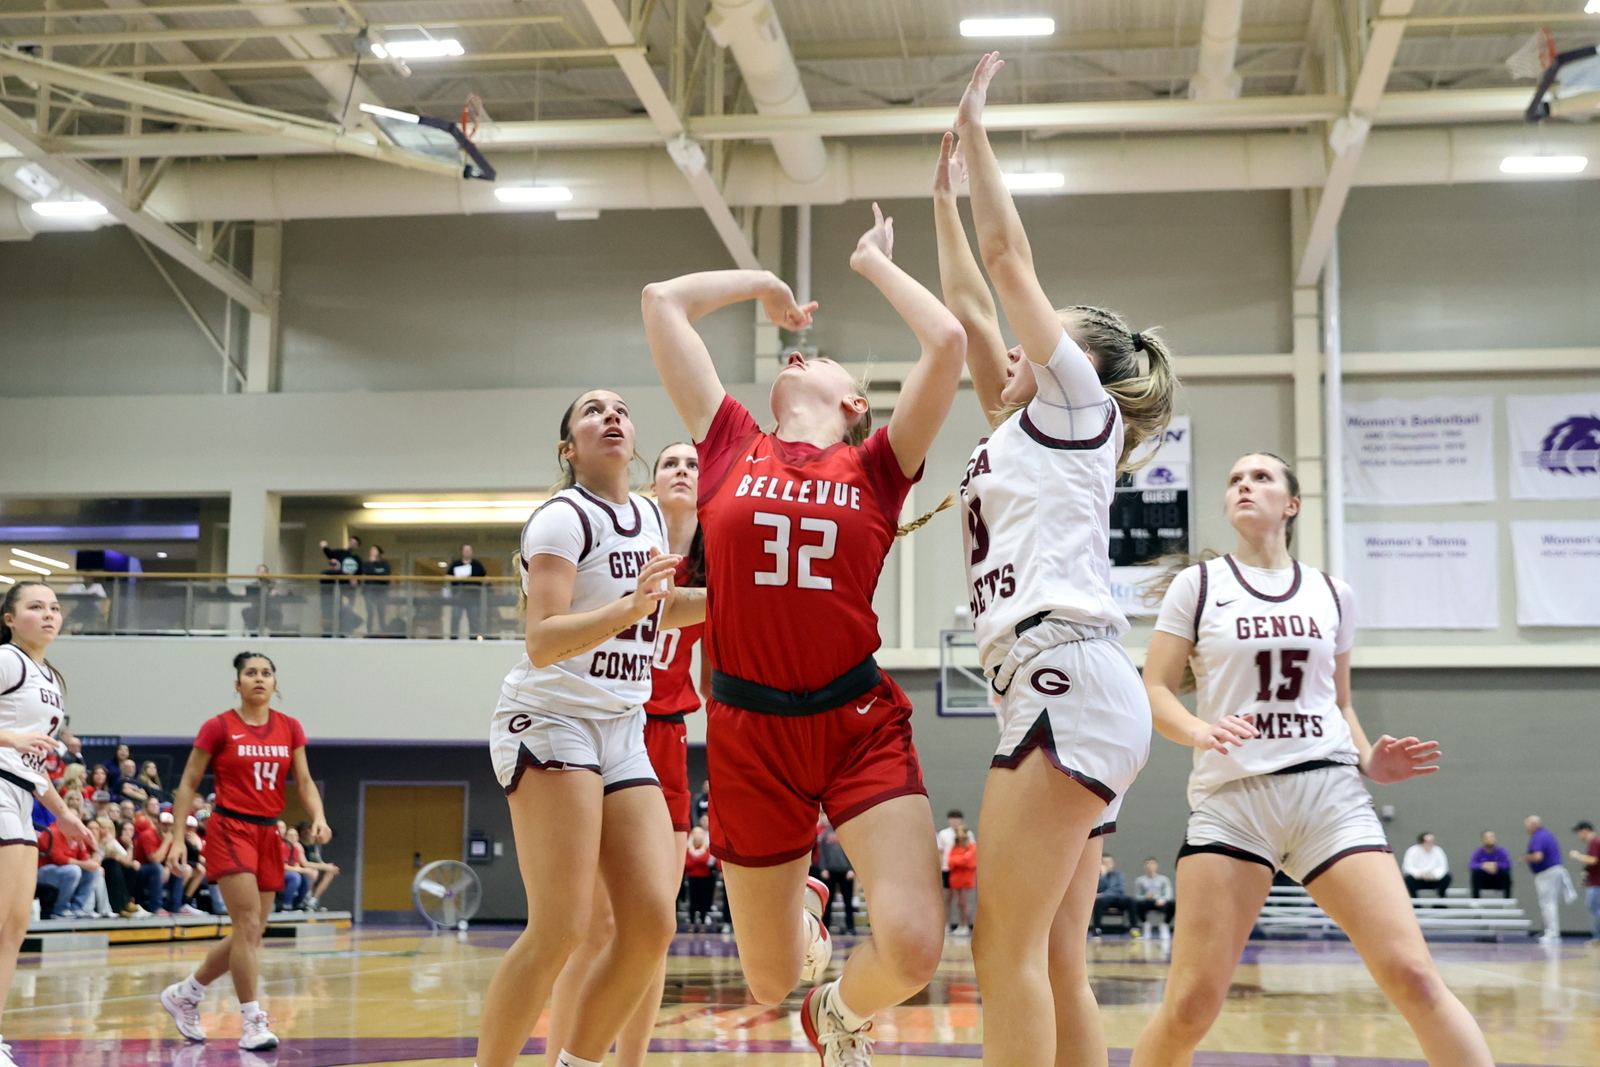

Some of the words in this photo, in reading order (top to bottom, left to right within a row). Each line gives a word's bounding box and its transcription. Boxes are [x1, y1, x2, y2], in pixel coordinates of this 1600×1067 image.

[735, 474, 860, 511] BELLEVUE
[1142, 490, 1178, 504] GUEST
[753, 511, 838, 590] 32
[1236, 615, 1323, 641] GENOA
[1031, 668, 1071, 696] G
[1254, 648, 1311, 702] 15
[508, 713, 533, 734] G
[237, 744, 290, 758] BELLEVUE
[253, 761, 280, 791] 14
